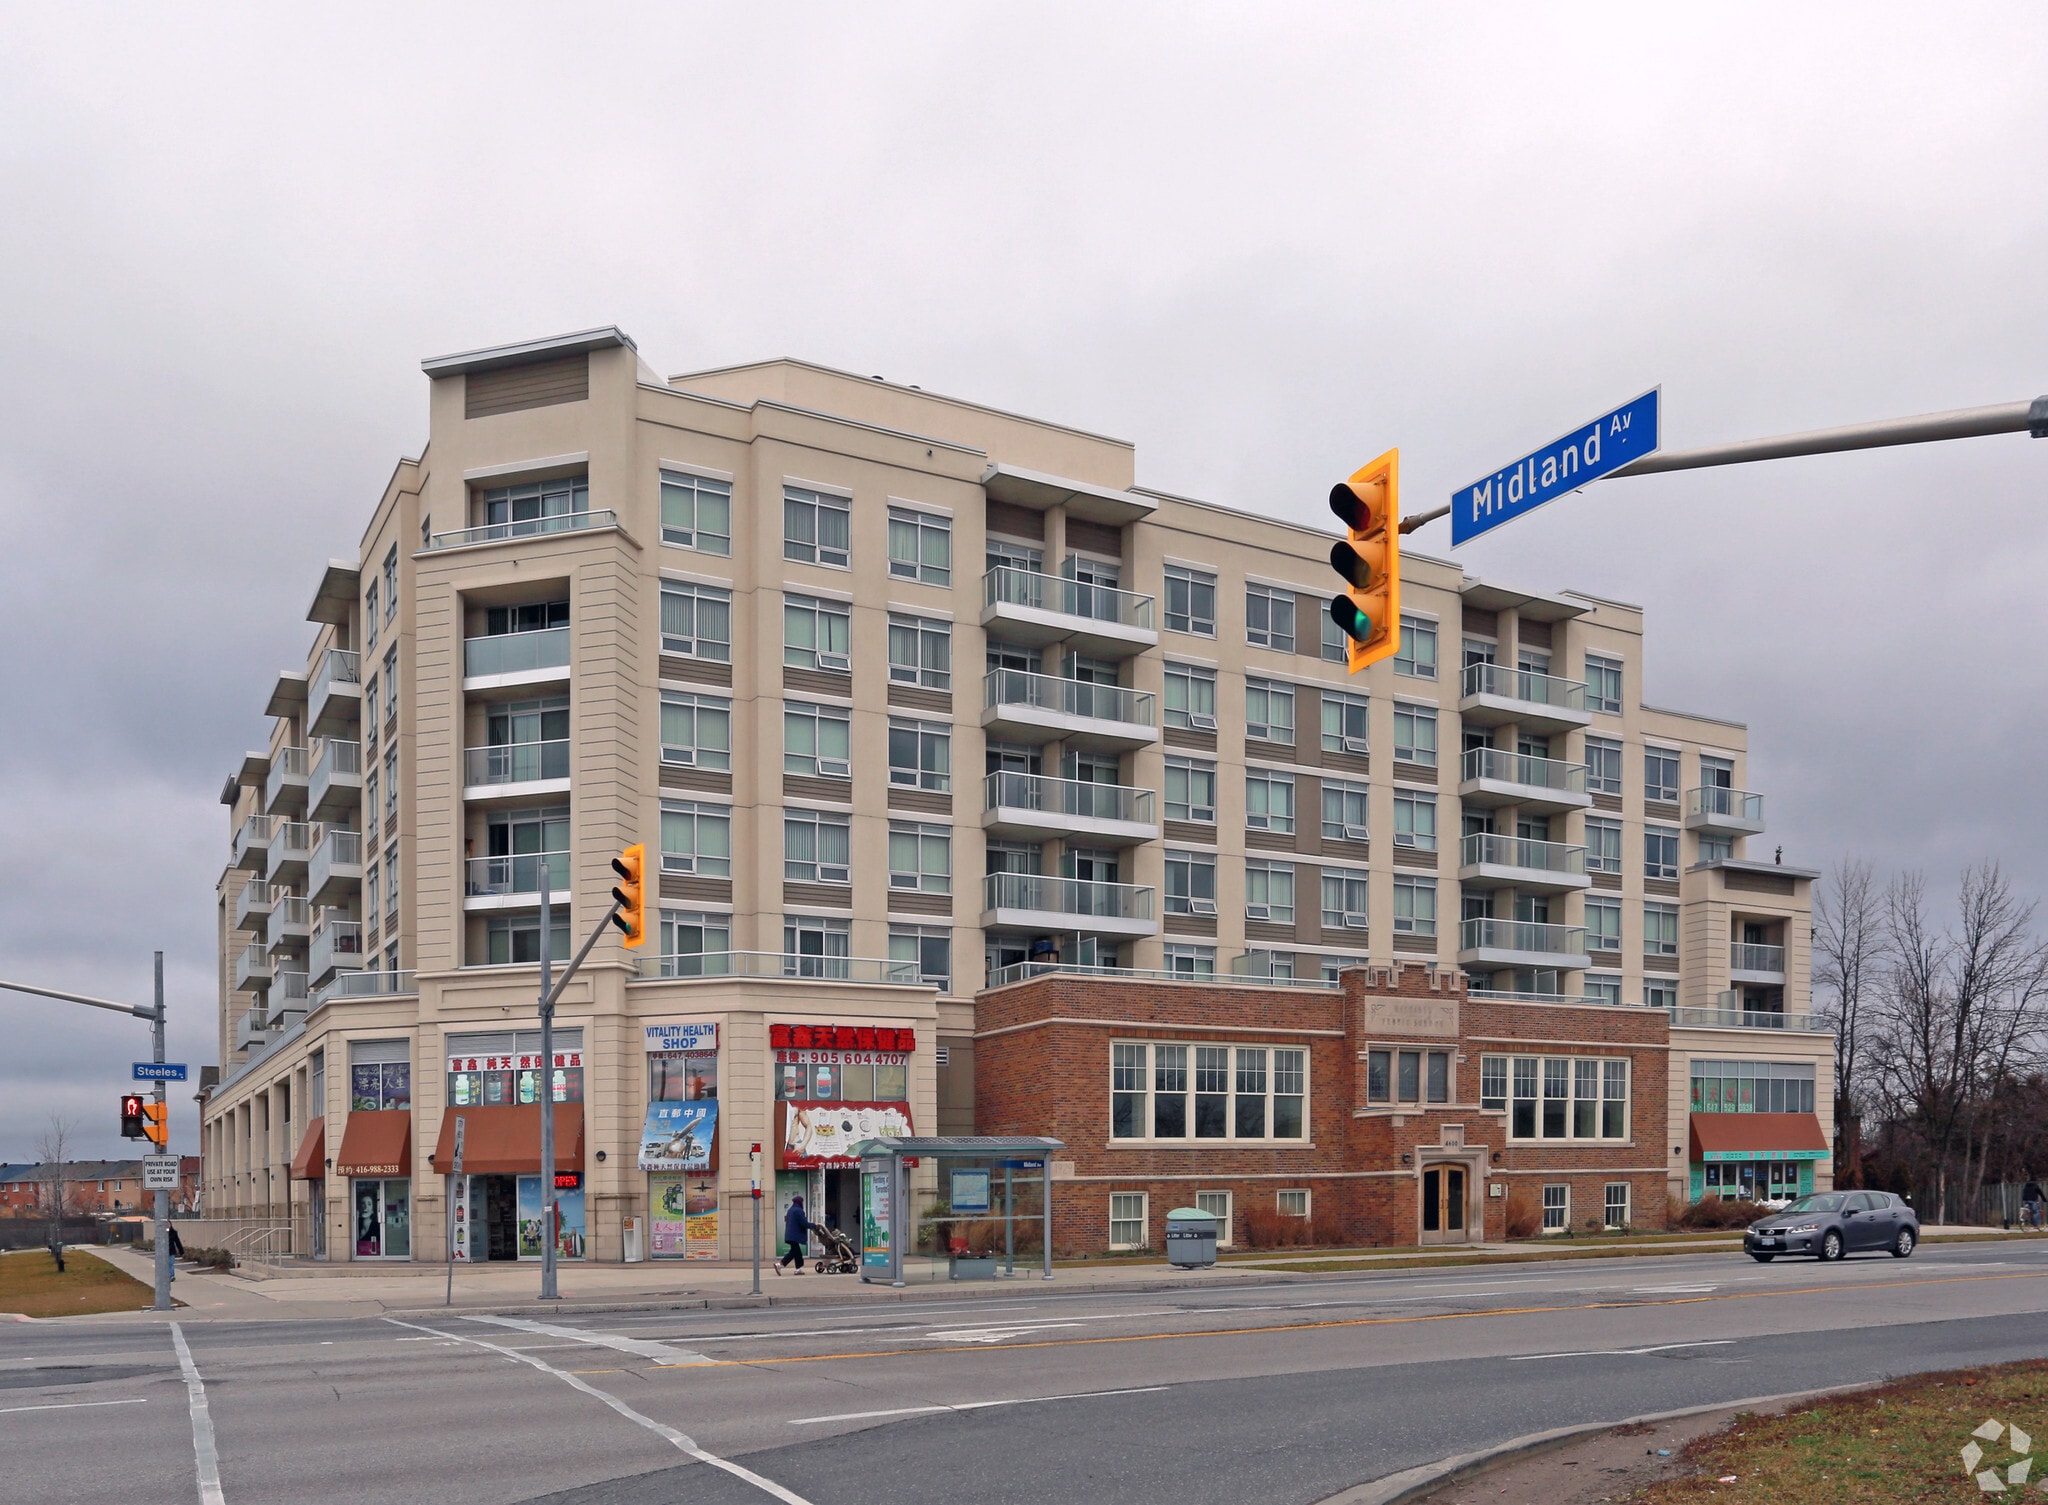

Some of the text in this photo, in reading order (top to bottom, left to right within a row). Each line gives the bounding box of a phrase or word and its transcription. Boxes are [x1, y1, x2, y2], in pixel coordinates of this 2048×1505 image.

[1472, 411, 1632, 522] Midland Av
[646, 1024, 714, 1037] VITALITY HEALTH
[662, 1038, 697, 1049] SHOP
[668, 1051, 681, 1059] 647
[811, 1052, 839, 1064] 905
[844, 1053, 872, 1065] 604
[875, 1054, 906, 1065] 4707
[137, 1066, 178, 1077] Steeles
[358, 1076, 406, 1091] 漂亮人生
[355, 1165, 399, 1174] 416-988-2333
[554, 1175, 577, 1187] OPEN
